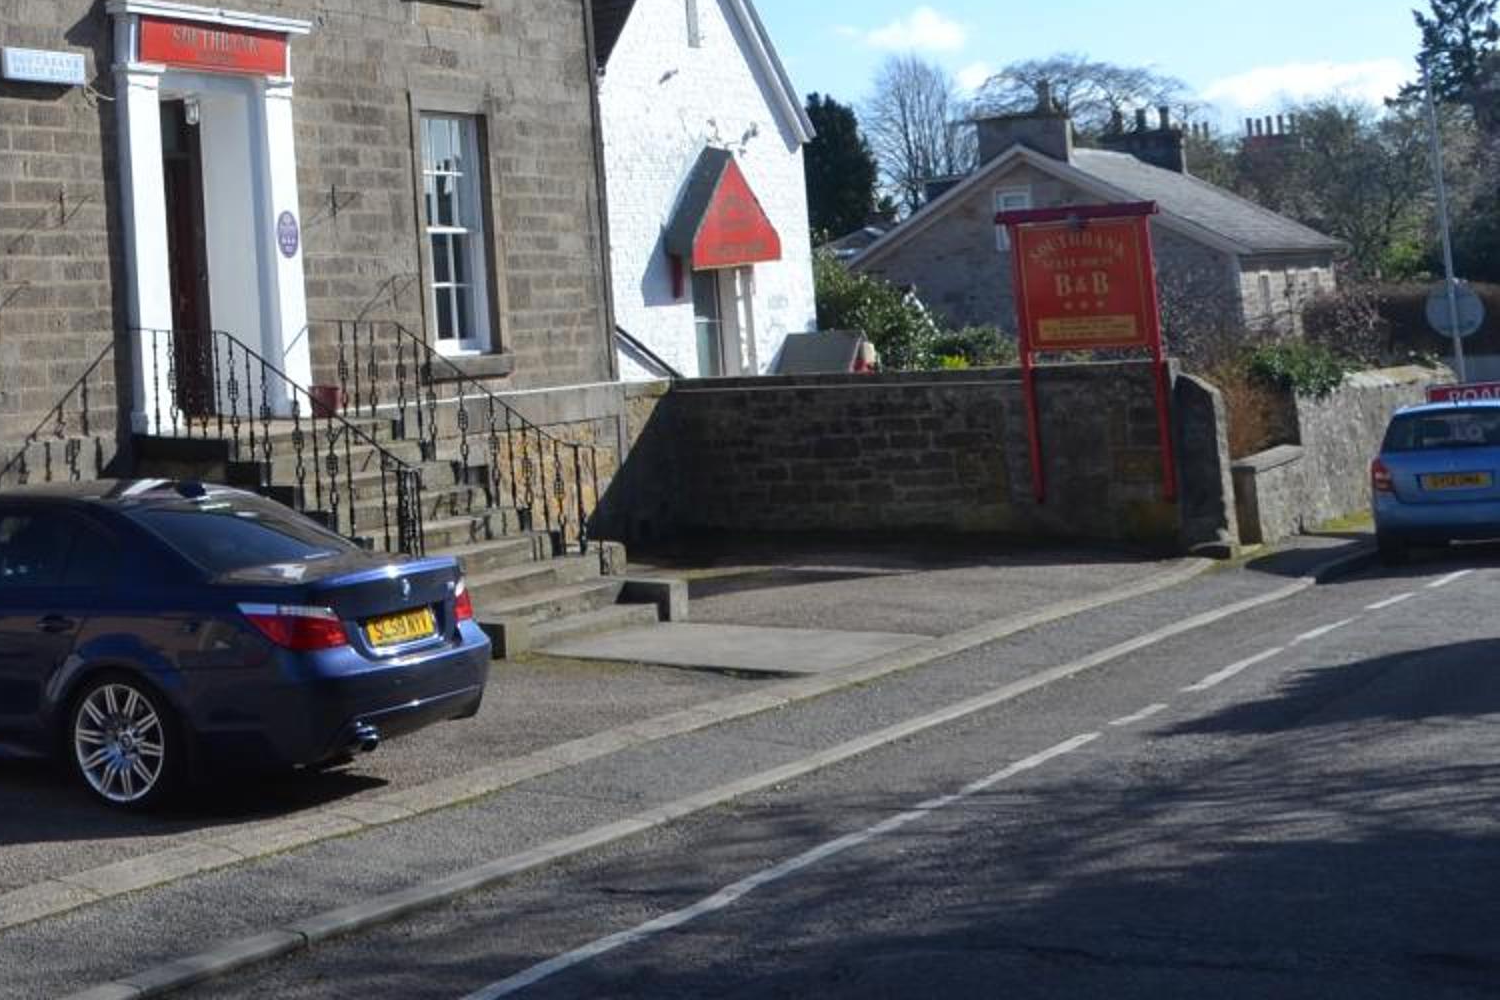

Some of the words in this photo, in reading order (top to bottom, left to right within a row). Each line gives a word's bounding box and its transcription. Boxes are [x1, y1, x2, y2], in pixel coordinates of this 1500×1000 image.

[1054, 273, 1071, 297] B
[1075, 276, 1088, 293] &
[1091, 271, 1109, 295] B
